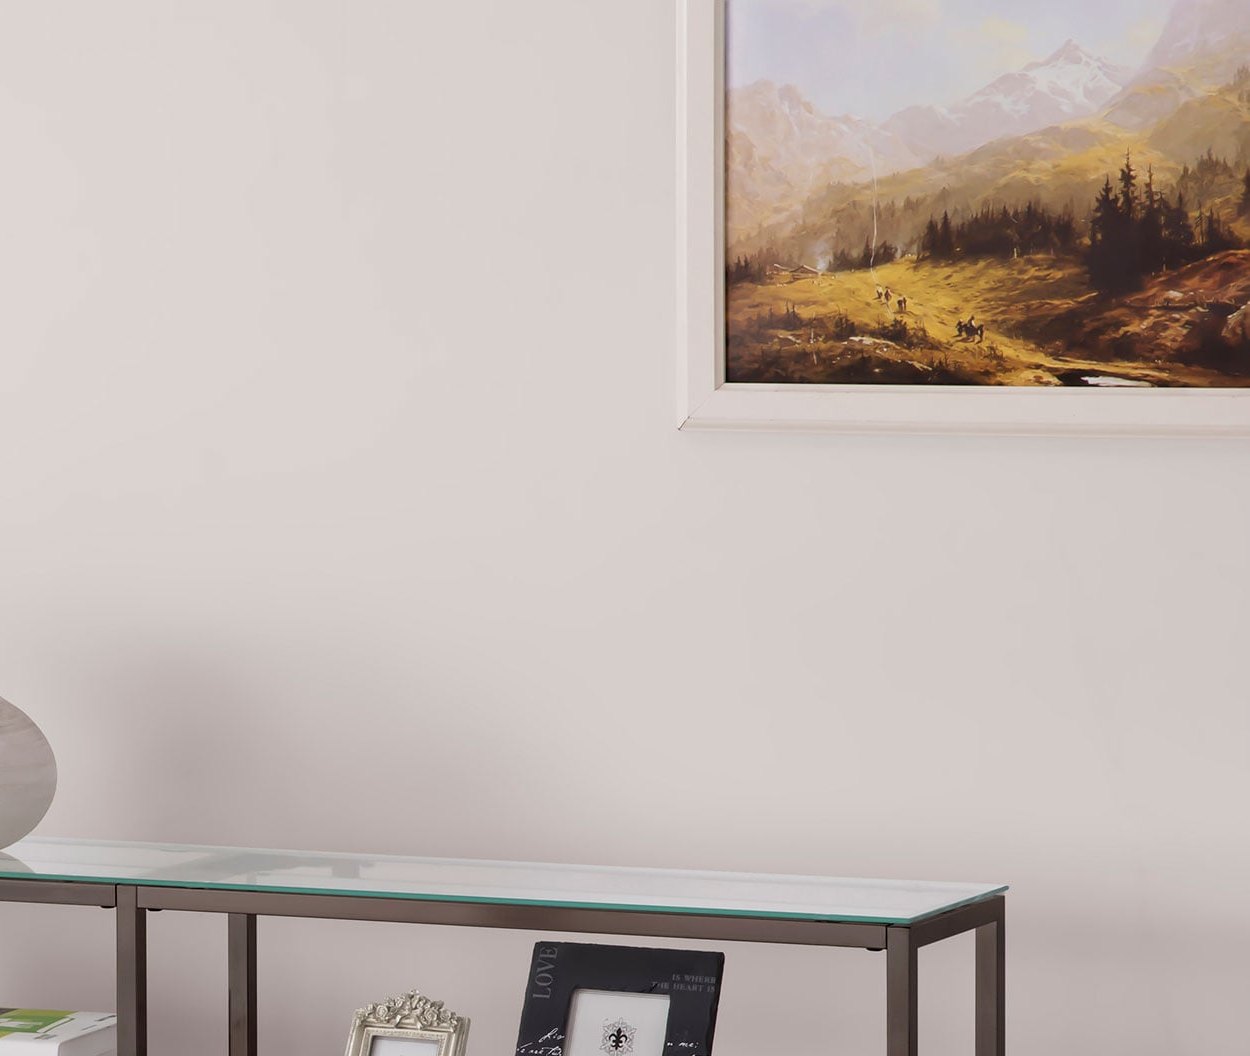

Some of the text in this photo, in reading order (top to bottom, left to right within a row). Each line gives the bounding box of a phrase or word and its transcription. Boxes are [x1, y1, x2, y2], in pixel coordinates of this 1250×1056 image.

[532, 946, 558, 999] LOVE
[672, 974, 716, 984] IS WHERE
[706, 985, 716, 993] IS
